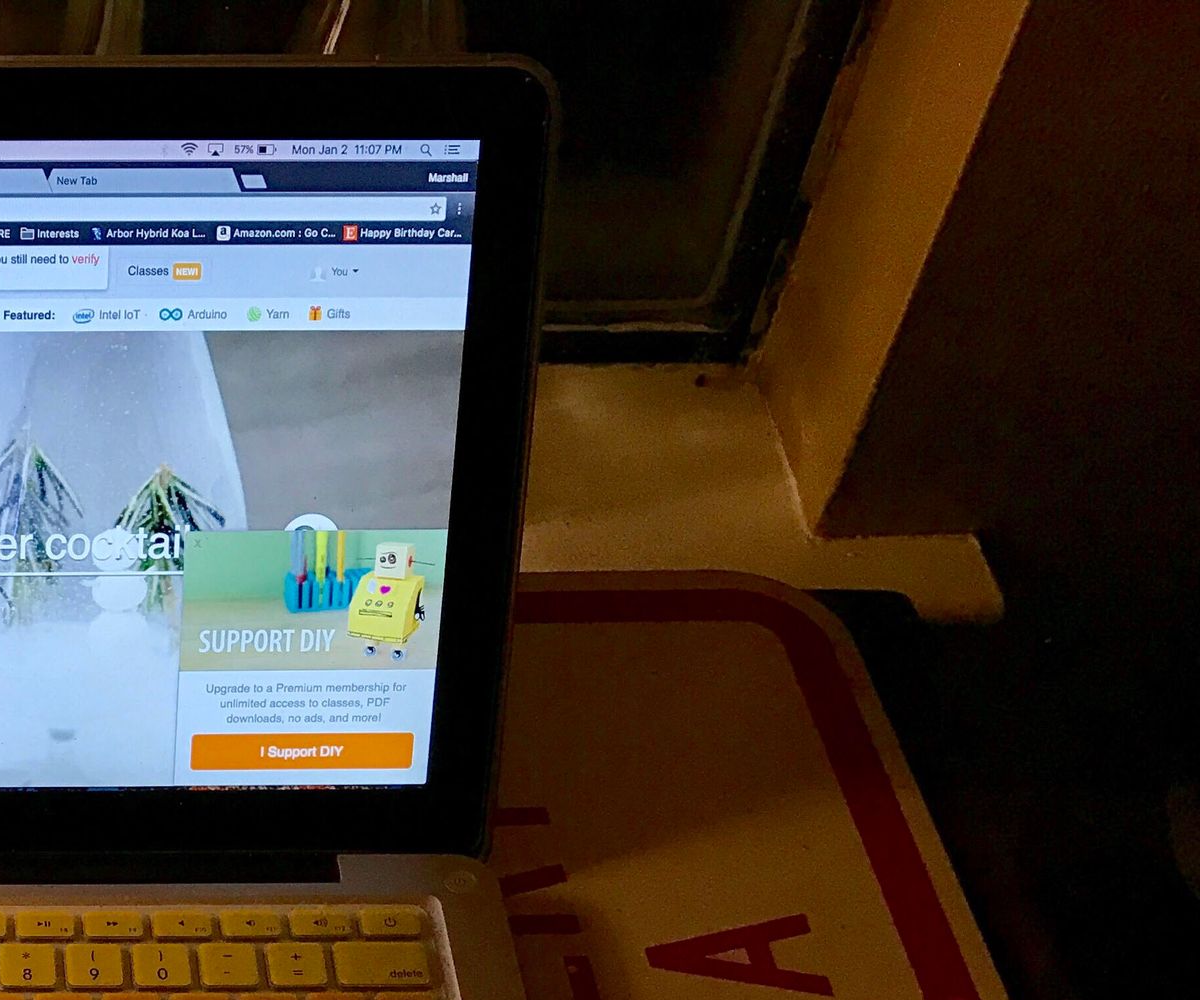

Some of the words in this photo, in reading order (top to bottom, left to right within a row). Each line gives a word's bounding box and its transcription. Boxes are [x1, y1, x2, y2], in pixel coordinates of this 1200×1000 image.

[234, 144, 254, 155] 57%
[292, 144, 315, 155] Mon
[318, 144, 338, 155] Jan
[340, 144, 348, 155] 2
[355, 144, 382, 155] 11:07
[384, 144, 402, 155] PM
[56, 176, 76, 187] New
[79, 176, 98, 187] Tab
[428, 172, 469, 183] Marshall
[37, 228, 80, 239] Interests
[106, 228, 134, 239] Arbor
[136, 228, 169, 240] Hybrid
[172, 228, 190, 238] Koa
[233, 228, 296, 238] Amazon.com
[304, 228, 318, 238] Go
[360, 228, 392, 241] Happy
[394, 228, 434, 241] Birthday
[10, 254, 28, 265] still
[30, 254, 57, 265] need
[59, 254, 70, 265] to
[72, 254, 100, 266] verify
[128, 266, 169, 276] Classes
[176, 268, 199, 277] NEW!
[331, 267, 348, 277] You
[3, 310, 56, 320] Featured:
[98, 310, 122, 320] Intel
[124, 310, 141, 320] IoT
[188, 309, 228, 320] Arduino
[266, 309, 290, 320] Yarn
[326, 309, 351, 320] Gifts
[198, 628, 296, 653] SUPPORT
[300, 628, 336, 652] DIY
[206, 684, 250, 696] Upgrade
[253, 684, 264, 694] to
[266, 686, 273, 694] a
[276, 683, 322, 693] Premium
[326, 682, 390, 695] membership
[392, 682, 407, 692] for
[220, 698, 267, 708] unlimited
[270, 700, 306, 708] access
[308, 699, 319, 708] to
[322, 698, 364, 709] classes,
[366, 698, 390, 707] PDF
[226, 714, 285, 724] downloads,
[304, 714, 326, 724] ads,
[329, 713, 349, 722] and
[352, 713, 382, 722] more!
[260, 746, 264, 757] I
[268, 745, 317, 760] Support
[320, 745, 344, 757] DIY
[22, 968, 32, 982] 8
[90, 968, 100, 982] 9
[157, 968, 168, 982] 0
[390, 970, 423, 979] delete
